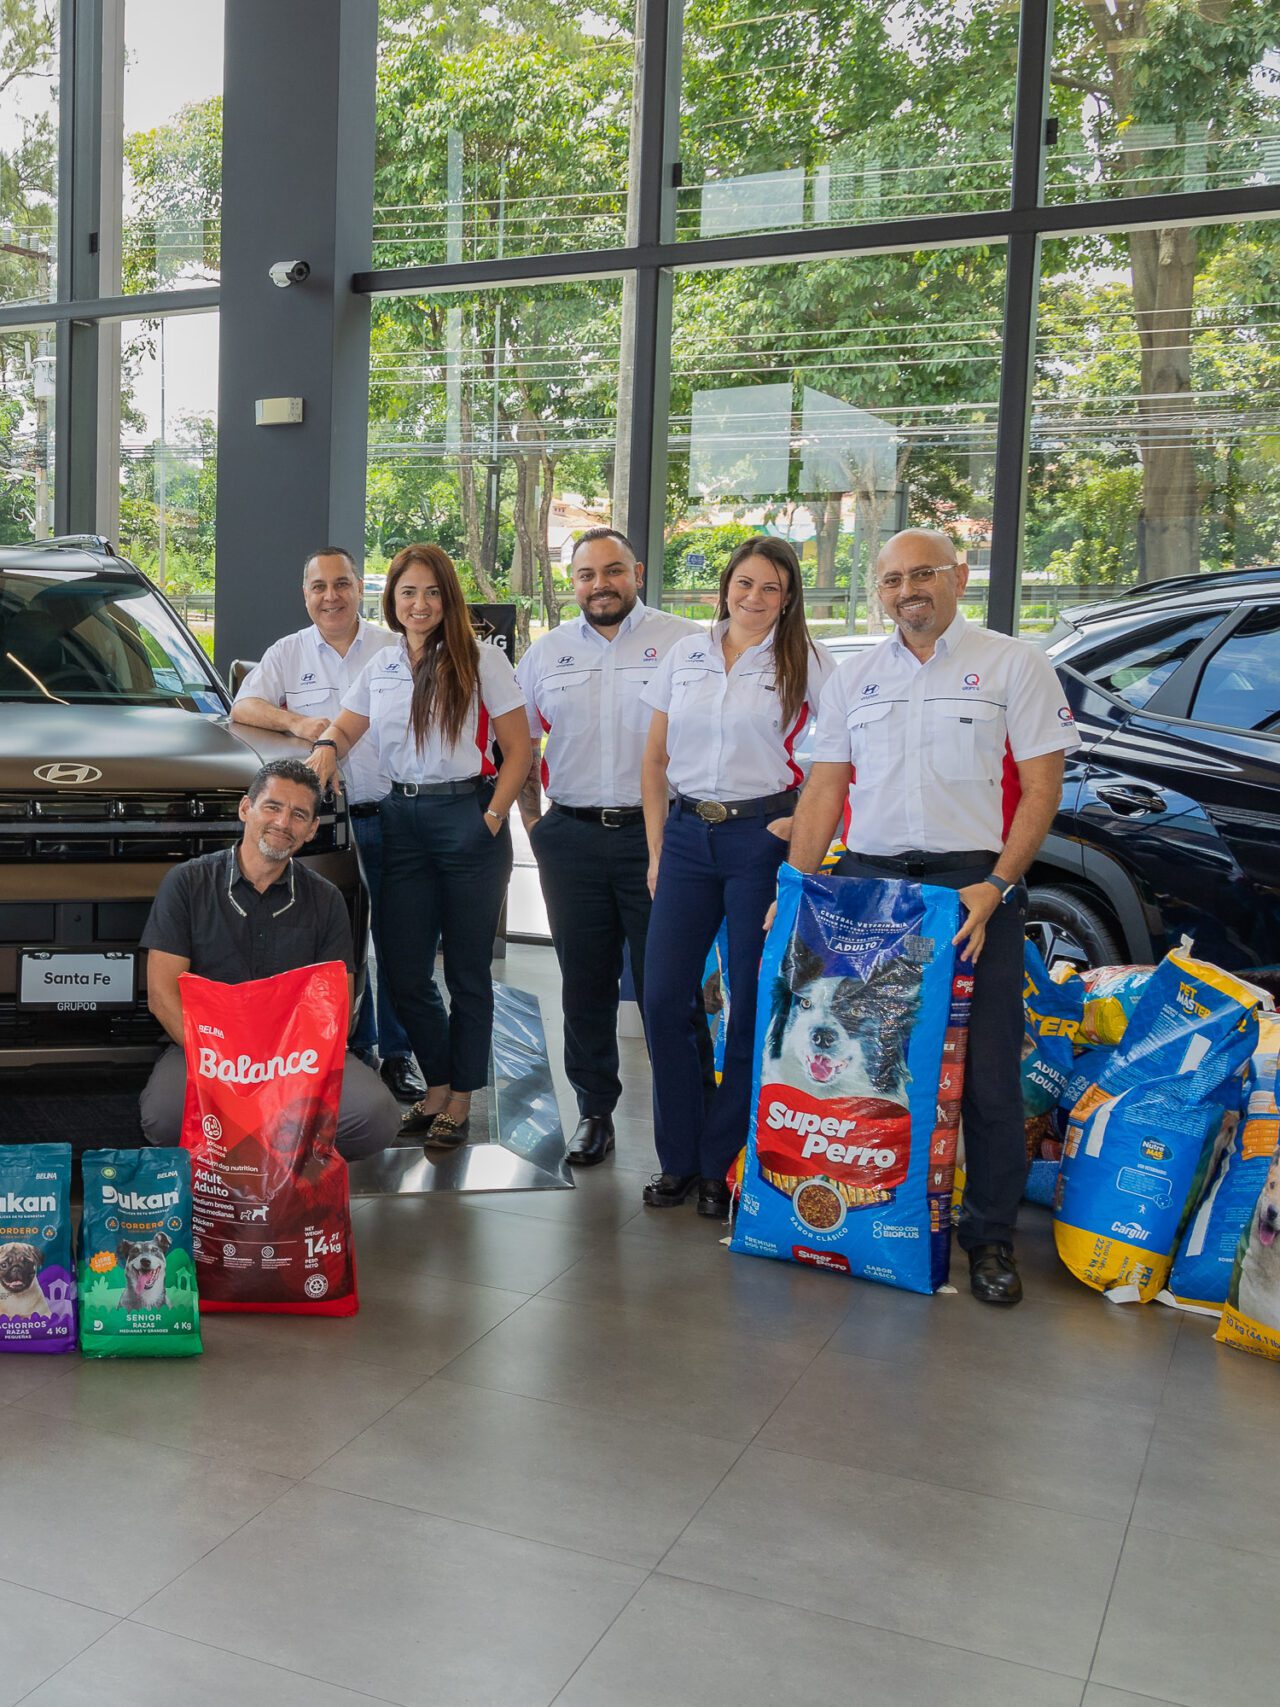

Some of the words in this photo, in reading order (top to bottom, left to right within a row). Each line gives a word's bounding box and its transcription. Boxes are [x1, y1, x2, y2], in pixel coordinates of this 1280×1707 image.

[820, 909, 854, 925] CENTRAL
[835, 941, 877, 952] ADULTO
[44, 971, 90, 985] Santa
[93, 972, 111, 985] Fe
[1180, 981, 1197, 1000] PET
[1176, 992, 1211, 1019] MASTER
[199, 1024, 224, 1039] BELINA
[199, 1047, 319, 1084] Balance
[766, 1101, 856, 1139] Super
[801, 1133, 896, 1169] Perro
[219, 1163, 230, 1171] dog
[36, 1172, 57, 1180] BELINA
[157, 1170, 178, 1179] BELINA
[195, 1169, 222, 1184] Adult
[194, 1181, 228, 1197] Adulto
[102, 1185, 179, 1209] Dukan
[215, 1202, 234, 1211] breeds
[206, 1209, 234, 1218] medianas
[121, 1221, 164, 1229] CORDERO
[192, 1216, 214, 1227] Chicken
[790, 1216, 813, 1238] SABOR
[883, 1231, 920, 1239] BIOPLUS
[1110, 1221, 1150, 1240] Cargill
[304, 1236, 329, 1257] 14
[330, 1243, 341, 1253] kg
[744, 1235, 777, 1248] PREMIUM
[798, 1250, 832, 1262] Super
[866, 1264, 893, 1274] SABOR
[1139, 1266, 1154, 1287] PET
[126, 1314, 162, 1322] SENIOR
[173, 1322, 179, 1330] 4
[182, 1322, 192, 1330] Kg
[1235, 1322, 1245, 1335] kg
